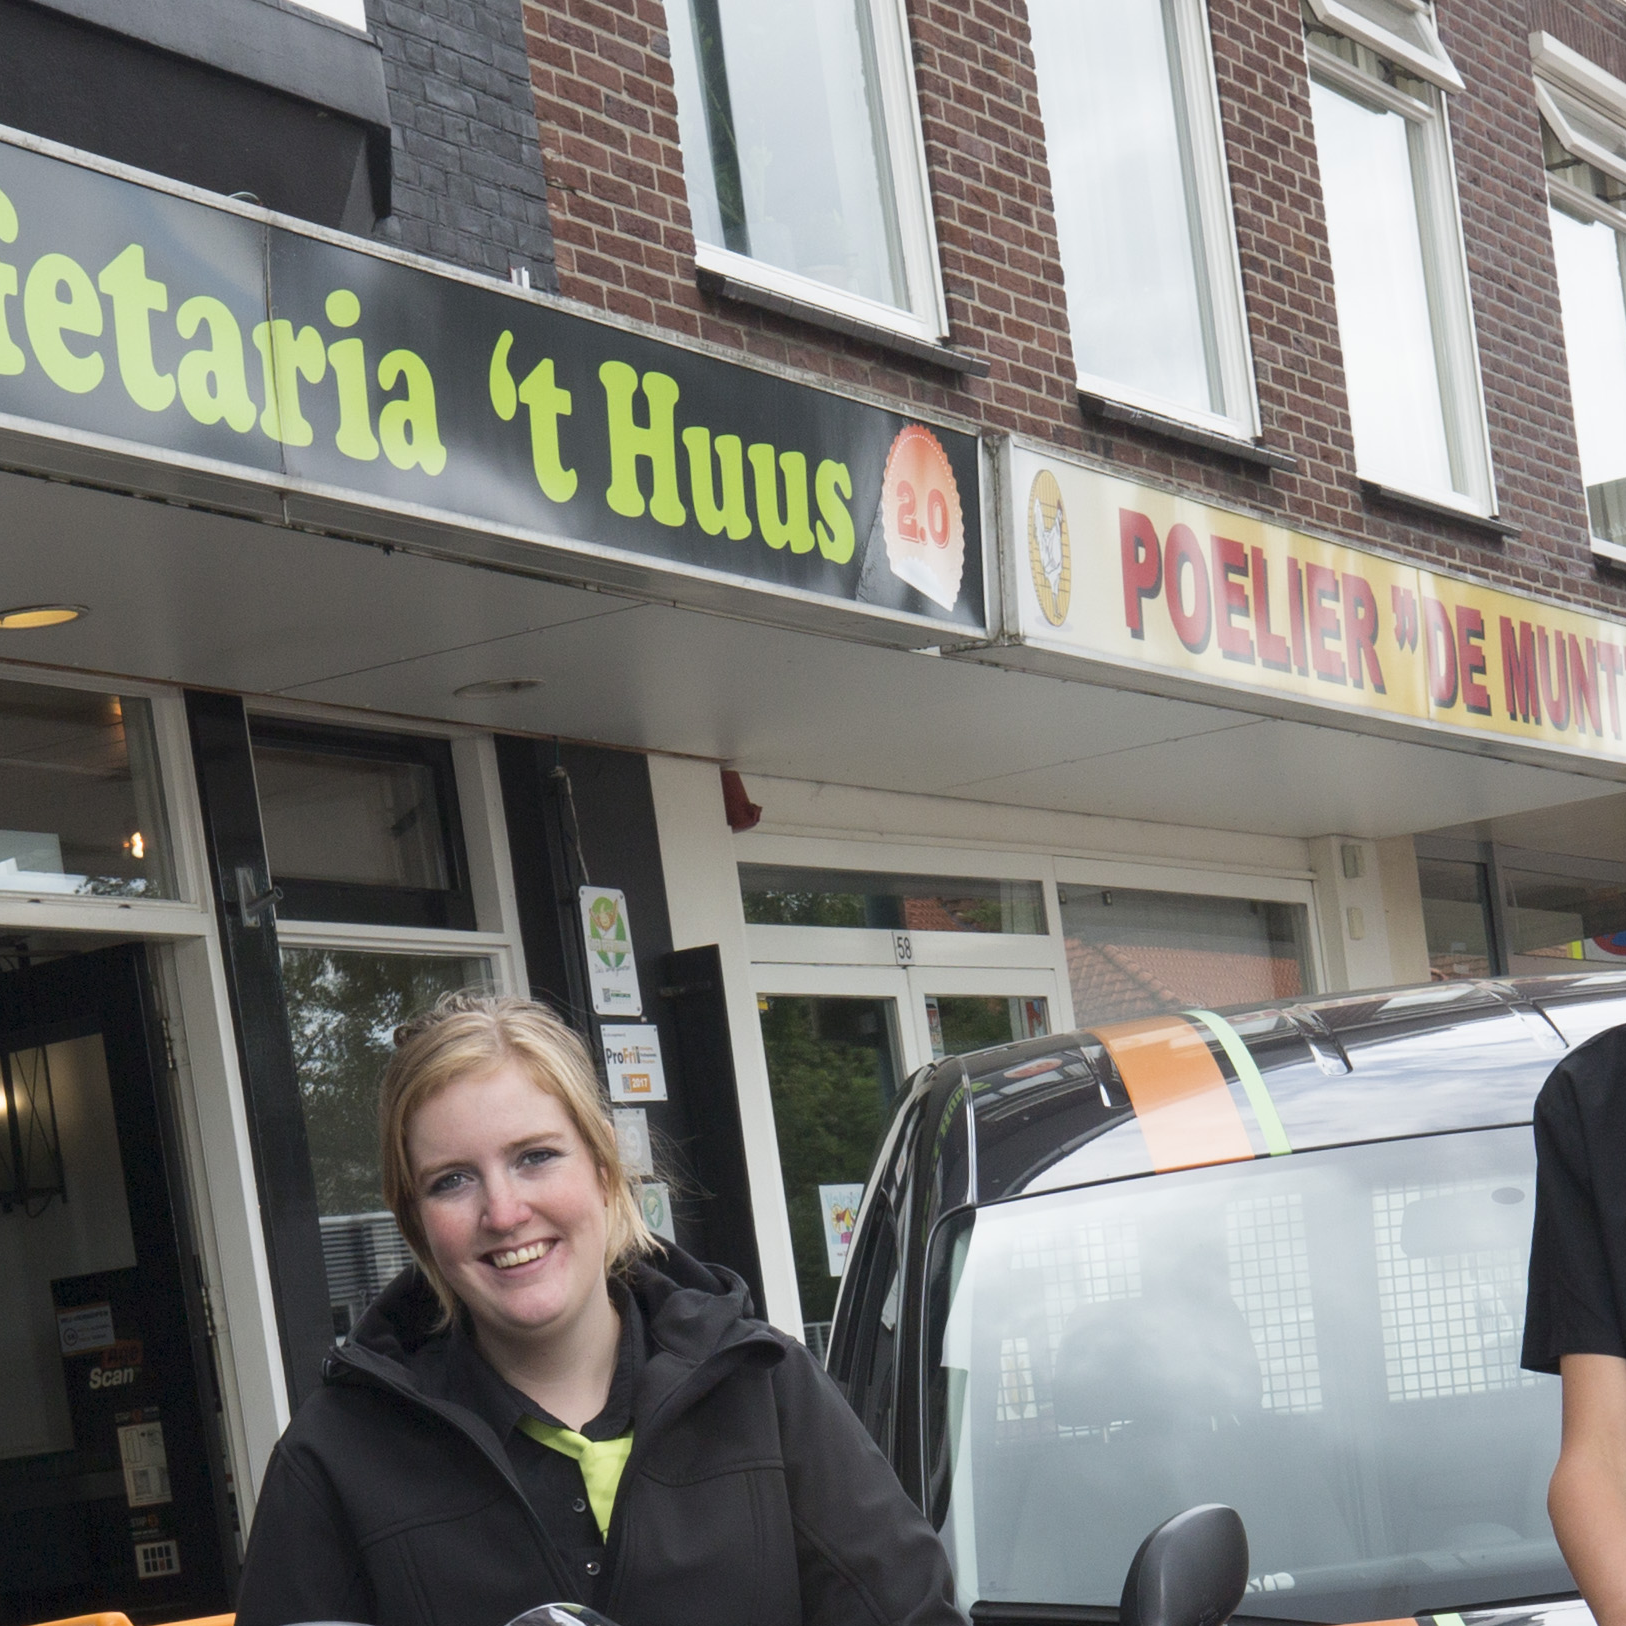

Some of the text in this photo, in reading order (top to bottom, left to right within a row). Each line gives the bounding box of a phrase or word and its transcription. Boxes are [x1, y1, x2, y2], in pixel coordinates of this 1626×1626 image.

[599, 360, 856, 565] Huus
[896, 479, 951, 549] 2.0
[1119, 506, 1387, 695] POELIER
[896, 936, 912, 960] 58
[631, 1077, 648, 1089] 2017
[89, 1367, 134, 1390] Scan
